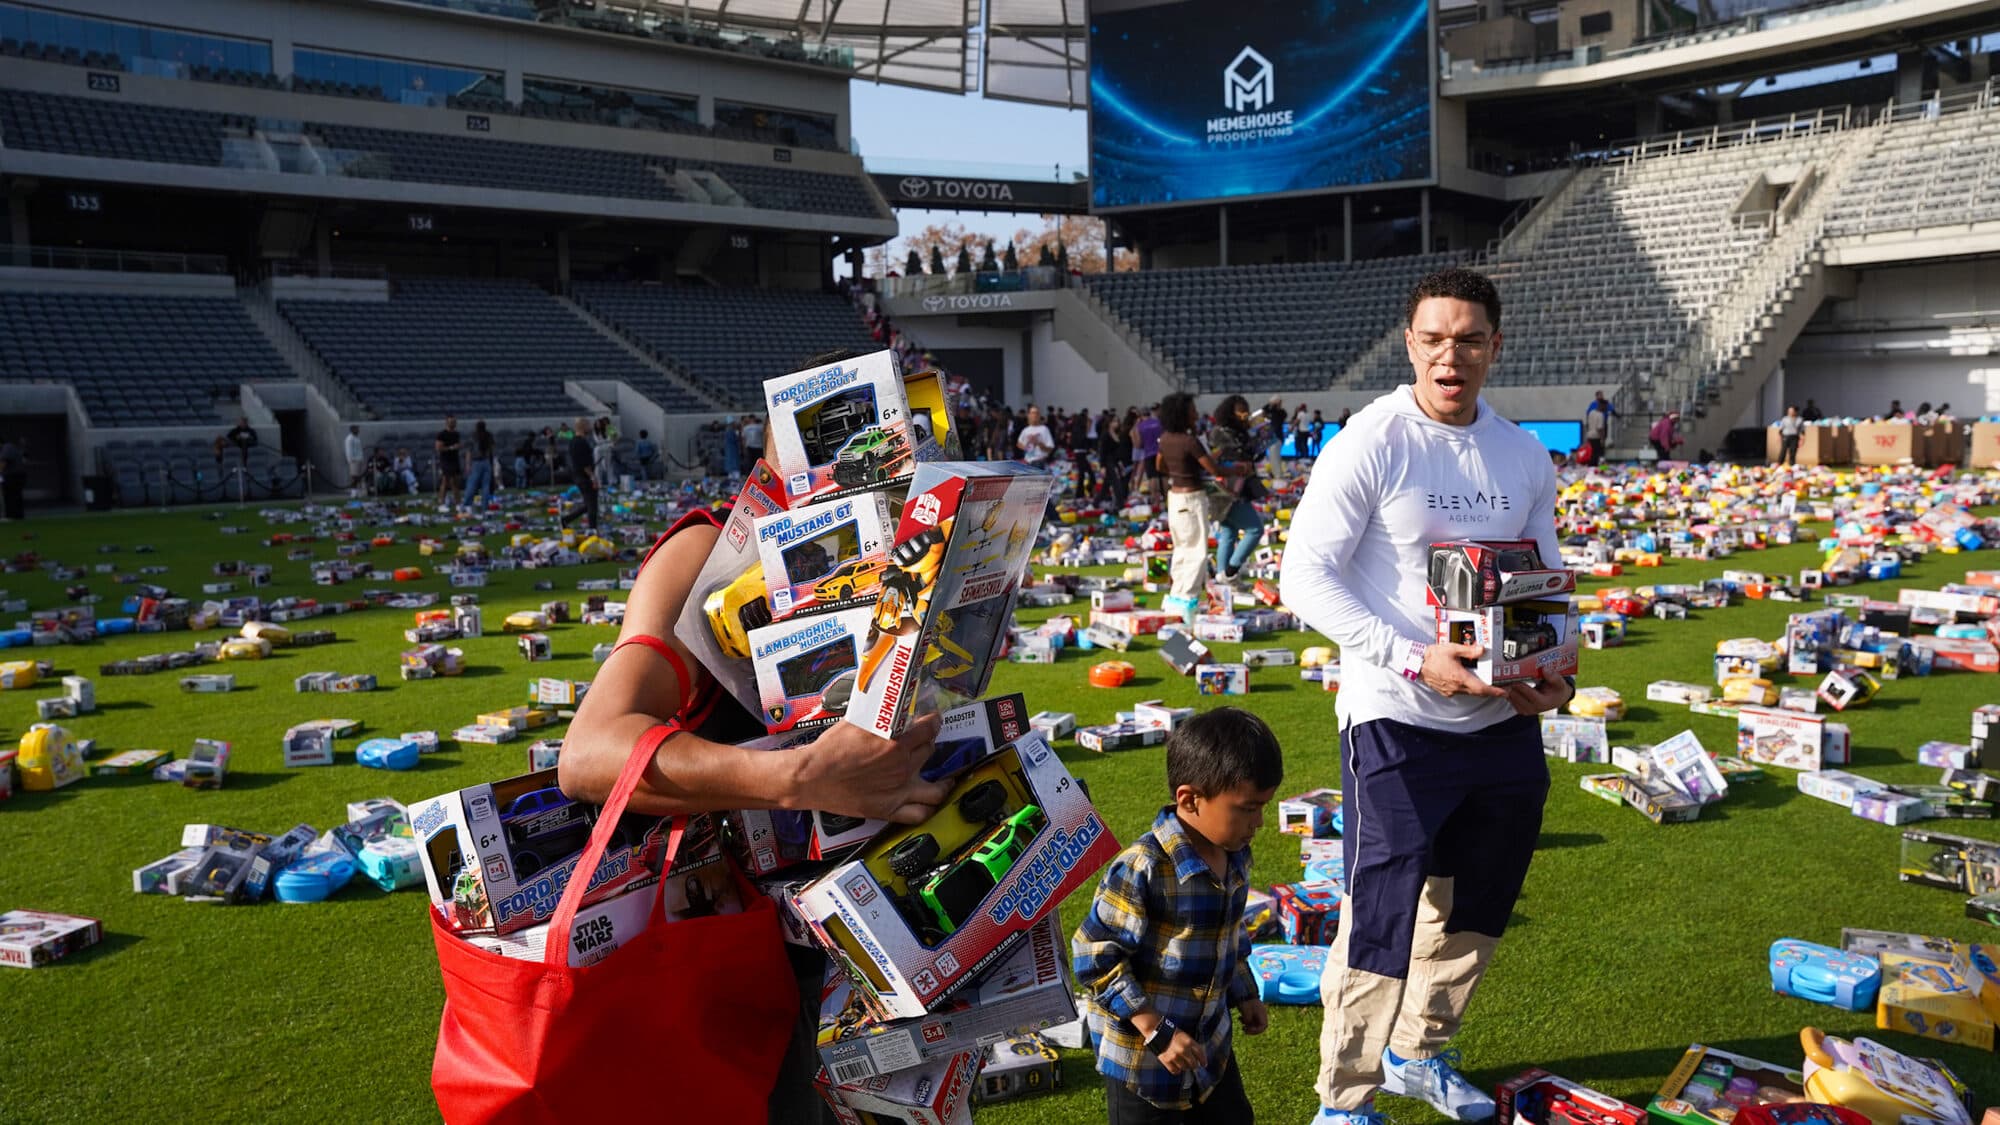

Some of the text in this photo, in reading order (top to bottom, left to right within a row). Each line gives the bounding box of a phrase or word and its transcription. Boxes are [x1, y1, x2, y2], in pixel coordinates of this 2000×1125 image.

[1206, 110, 1294, 133] MEMEHOUSE
[1207, 126, 1294, 143] PRODUCTIONS
[931, 179, 1013, 200] TOYOTA
[69, 194, 99, 210] 133
[411, 217, 432, 230] 134
[949, 294, 1013, 309] TOYOTA
[771, 365, 843, 408] FORD F-250
[793, 368, 858, 406] SUPER DUTY
[882, 408, 898, 420] 6+
[748, 483, 785, 514] LAMBO
[743, 505, 755, 517] 6+
[1448, 515, 1491, 523] AGENCY
[759, 517, 792, 542] FORD
[777, 511, 834, 547] MUSTANG
[834, 501, 853, 521] GT
[864, 541, 879, 552] 6+
[756, 616, 838, 660] LAMBORGHINI
[799, 624, 847, 650] HURACAN
[875, 645, 912, 732] TRANSFORMERS
[822, 715, 841, 725] CONT
[944, 710, 976, 725] ROADSTER
[480, 833, 498, 848] 6+
[752, 828, 768, 842] 6+
[988, 828, 1070, 925] SVT RAPTOR
[1018, 813, 1104, 920] FORD F-150
[497, 878, 553, 922] FORD
[573, 915, 612, 942] STAR
[574, 926, 613, 954] WARS
[1031, 914, 1057, 985] TRANSFORME
